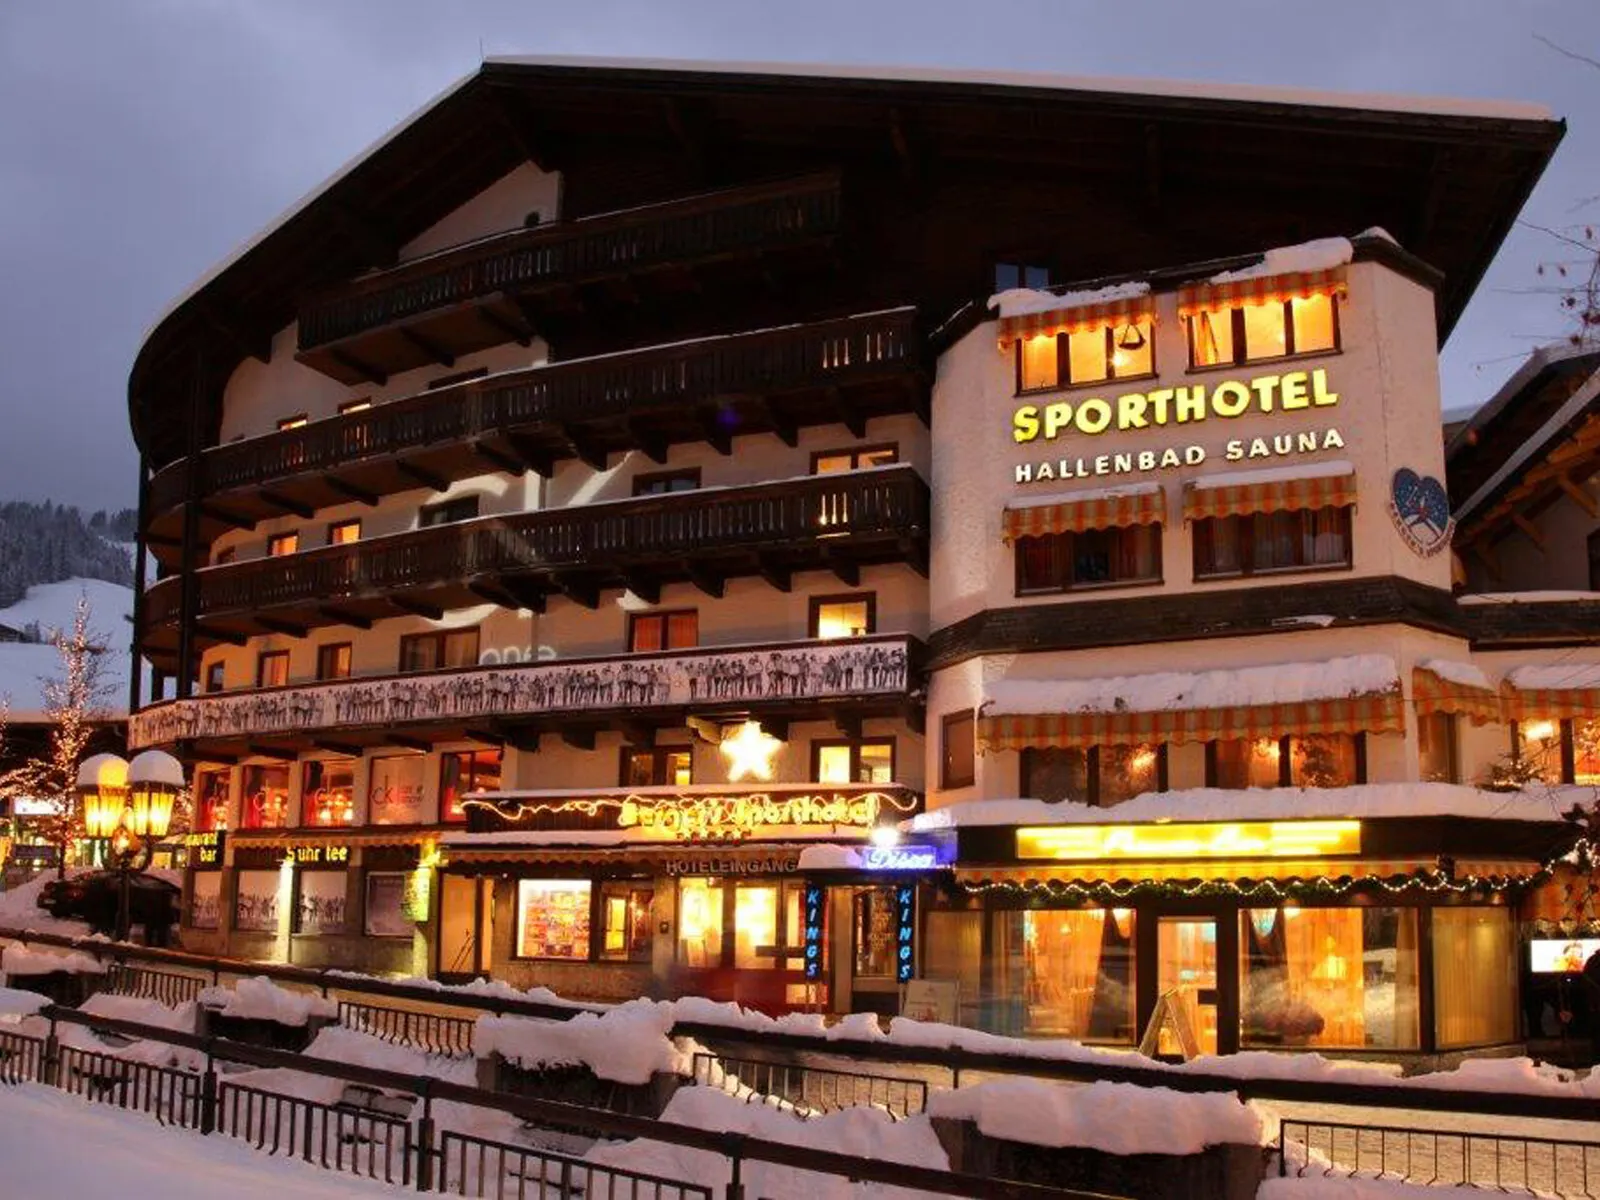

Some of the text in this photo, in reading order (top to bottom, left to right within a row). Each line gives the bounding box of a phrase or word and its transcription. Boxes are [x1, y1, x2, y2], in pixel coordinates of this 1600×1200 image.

[1012, 368, 1339, 444] SPORTHOTEL
[1015, 427, 1345, 484] HALLENBAD SAUNA
[806, 889, 820, 977] KINGS
[899, 889, 913, 979] KINGS
